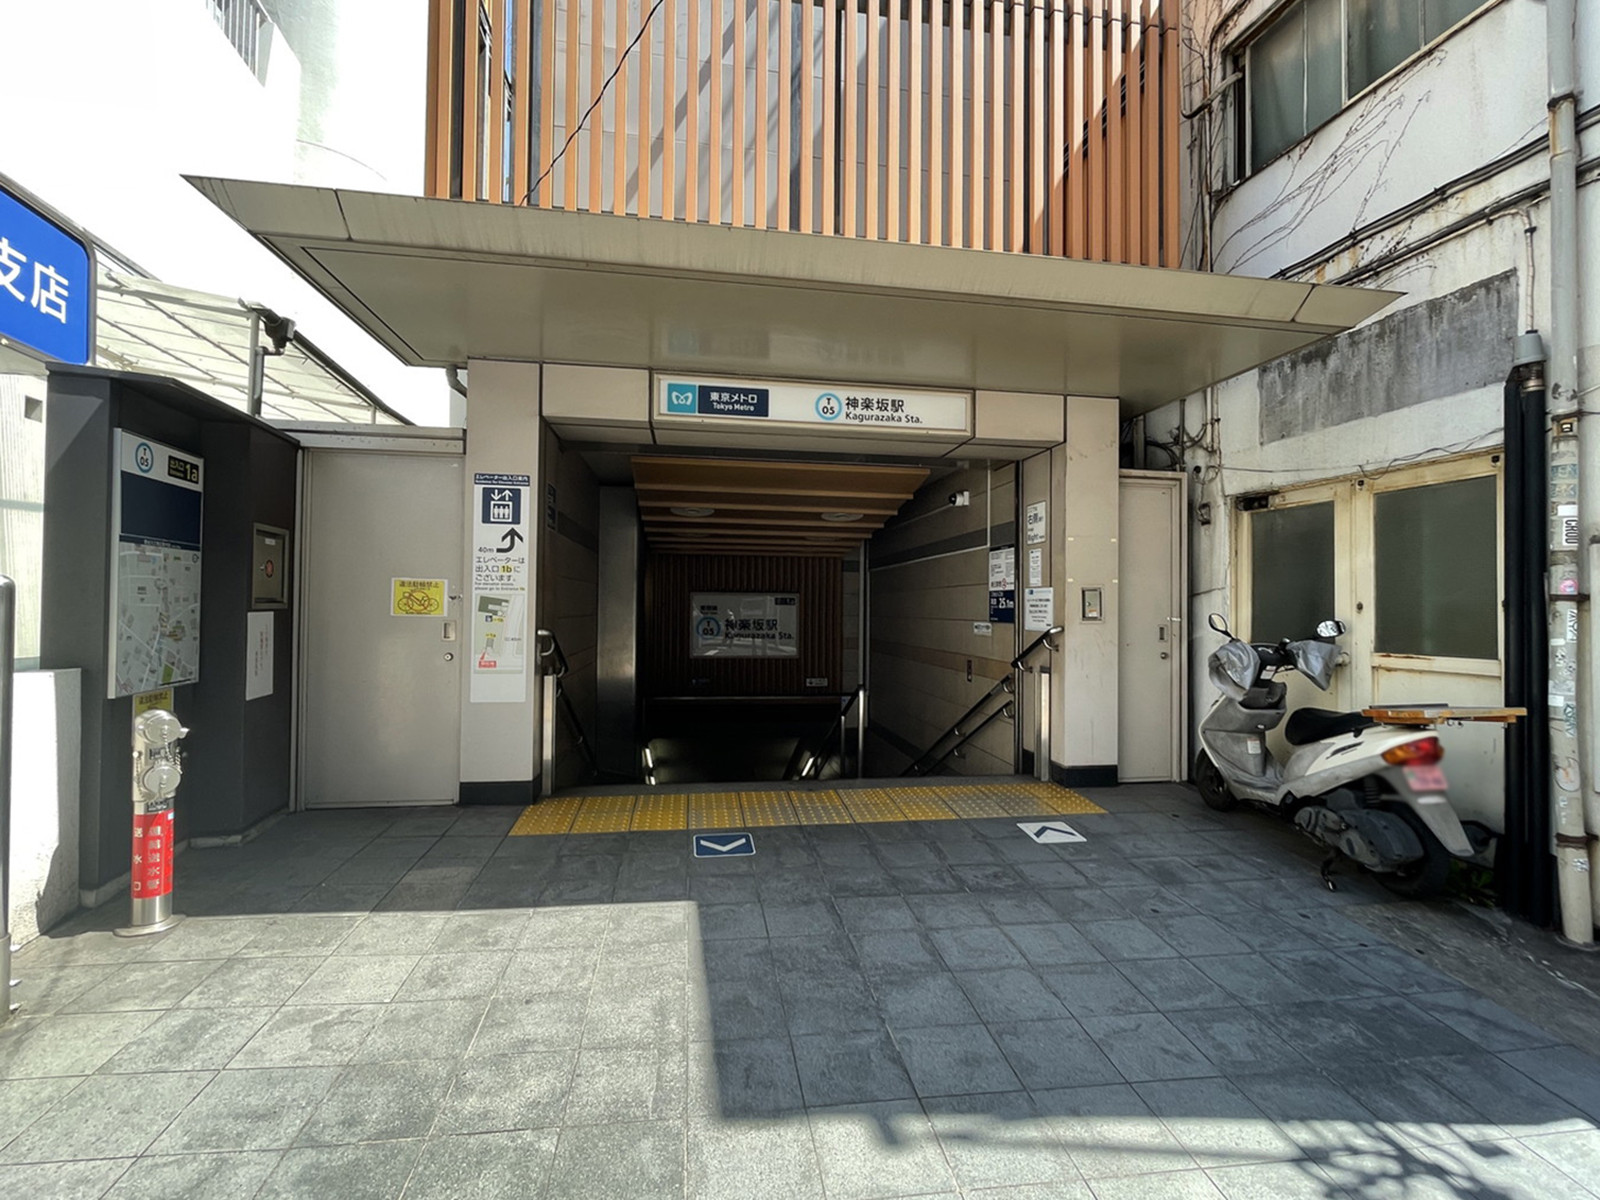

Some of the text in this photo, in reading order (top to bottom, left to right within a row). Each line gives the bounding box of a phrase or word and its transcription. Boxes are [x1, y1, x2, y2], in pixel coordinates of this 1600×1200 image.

[0, 236, 69, 325] 支店
[710, 391, 758, 404] 東京メトロ
[712, 402, 755, 411] Tokyo Metro
[821, 405, 836, 415] 05
[845, 396, 905, 413] 神楽坂駅
[845, 411, 924, 424] Kagurazaka Sta.
[140, 456, 150, 468] 05
[185, 463, 199, 482] 1a
[475, 556, 525, 565] エレベーターは
[725, 619, 778, 632] 神楽坂駅
[778, 632, 795, 640] Sta.
